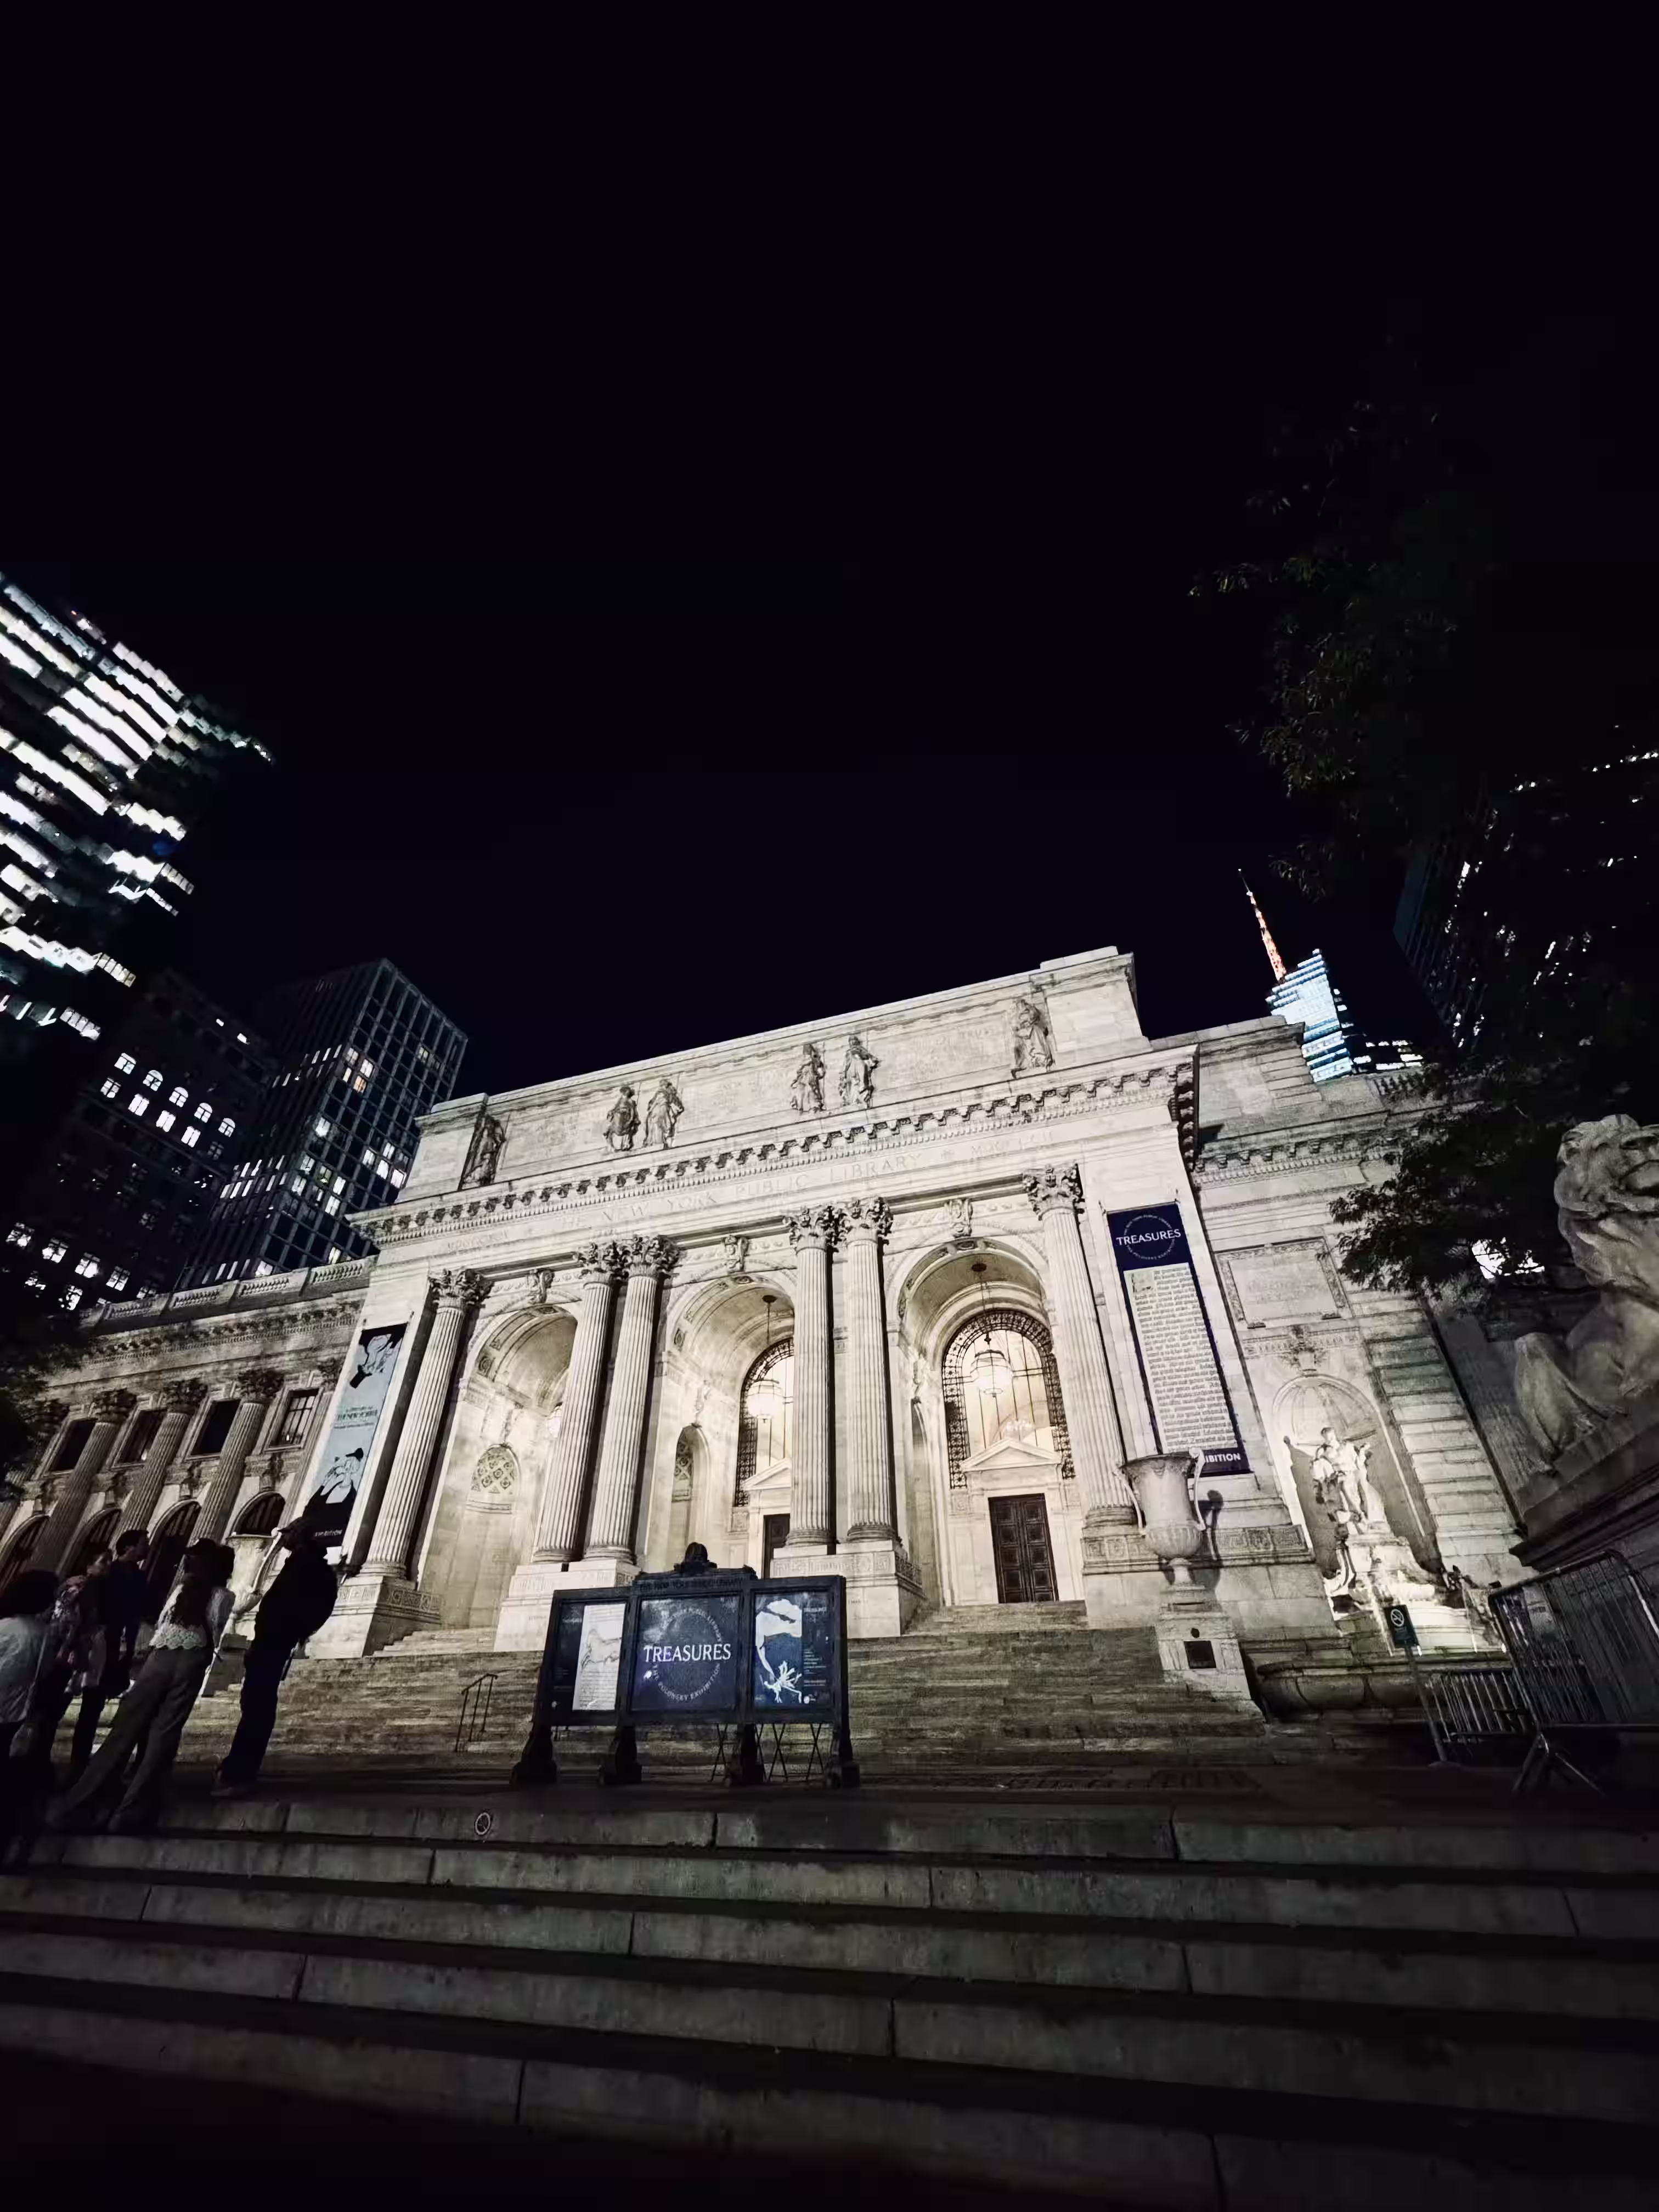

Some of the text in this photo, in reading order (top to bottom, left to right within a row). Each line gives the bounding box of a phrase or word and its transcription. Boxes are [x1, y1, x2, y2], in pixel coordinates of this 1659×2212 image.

[602, 1200, 650, 1221] NEW
[665, 1192, 716, 1212] YORK
[734, 1173, 809, 1196] PUBLIC
[830, 1153, 922, 1183] LIBRARY
[1116, 1229, 1181, 1245] TREASURES
[1205, 1452, 1241, 1463] IBITION
[644, 1644, 731, 1662] TREASURES
